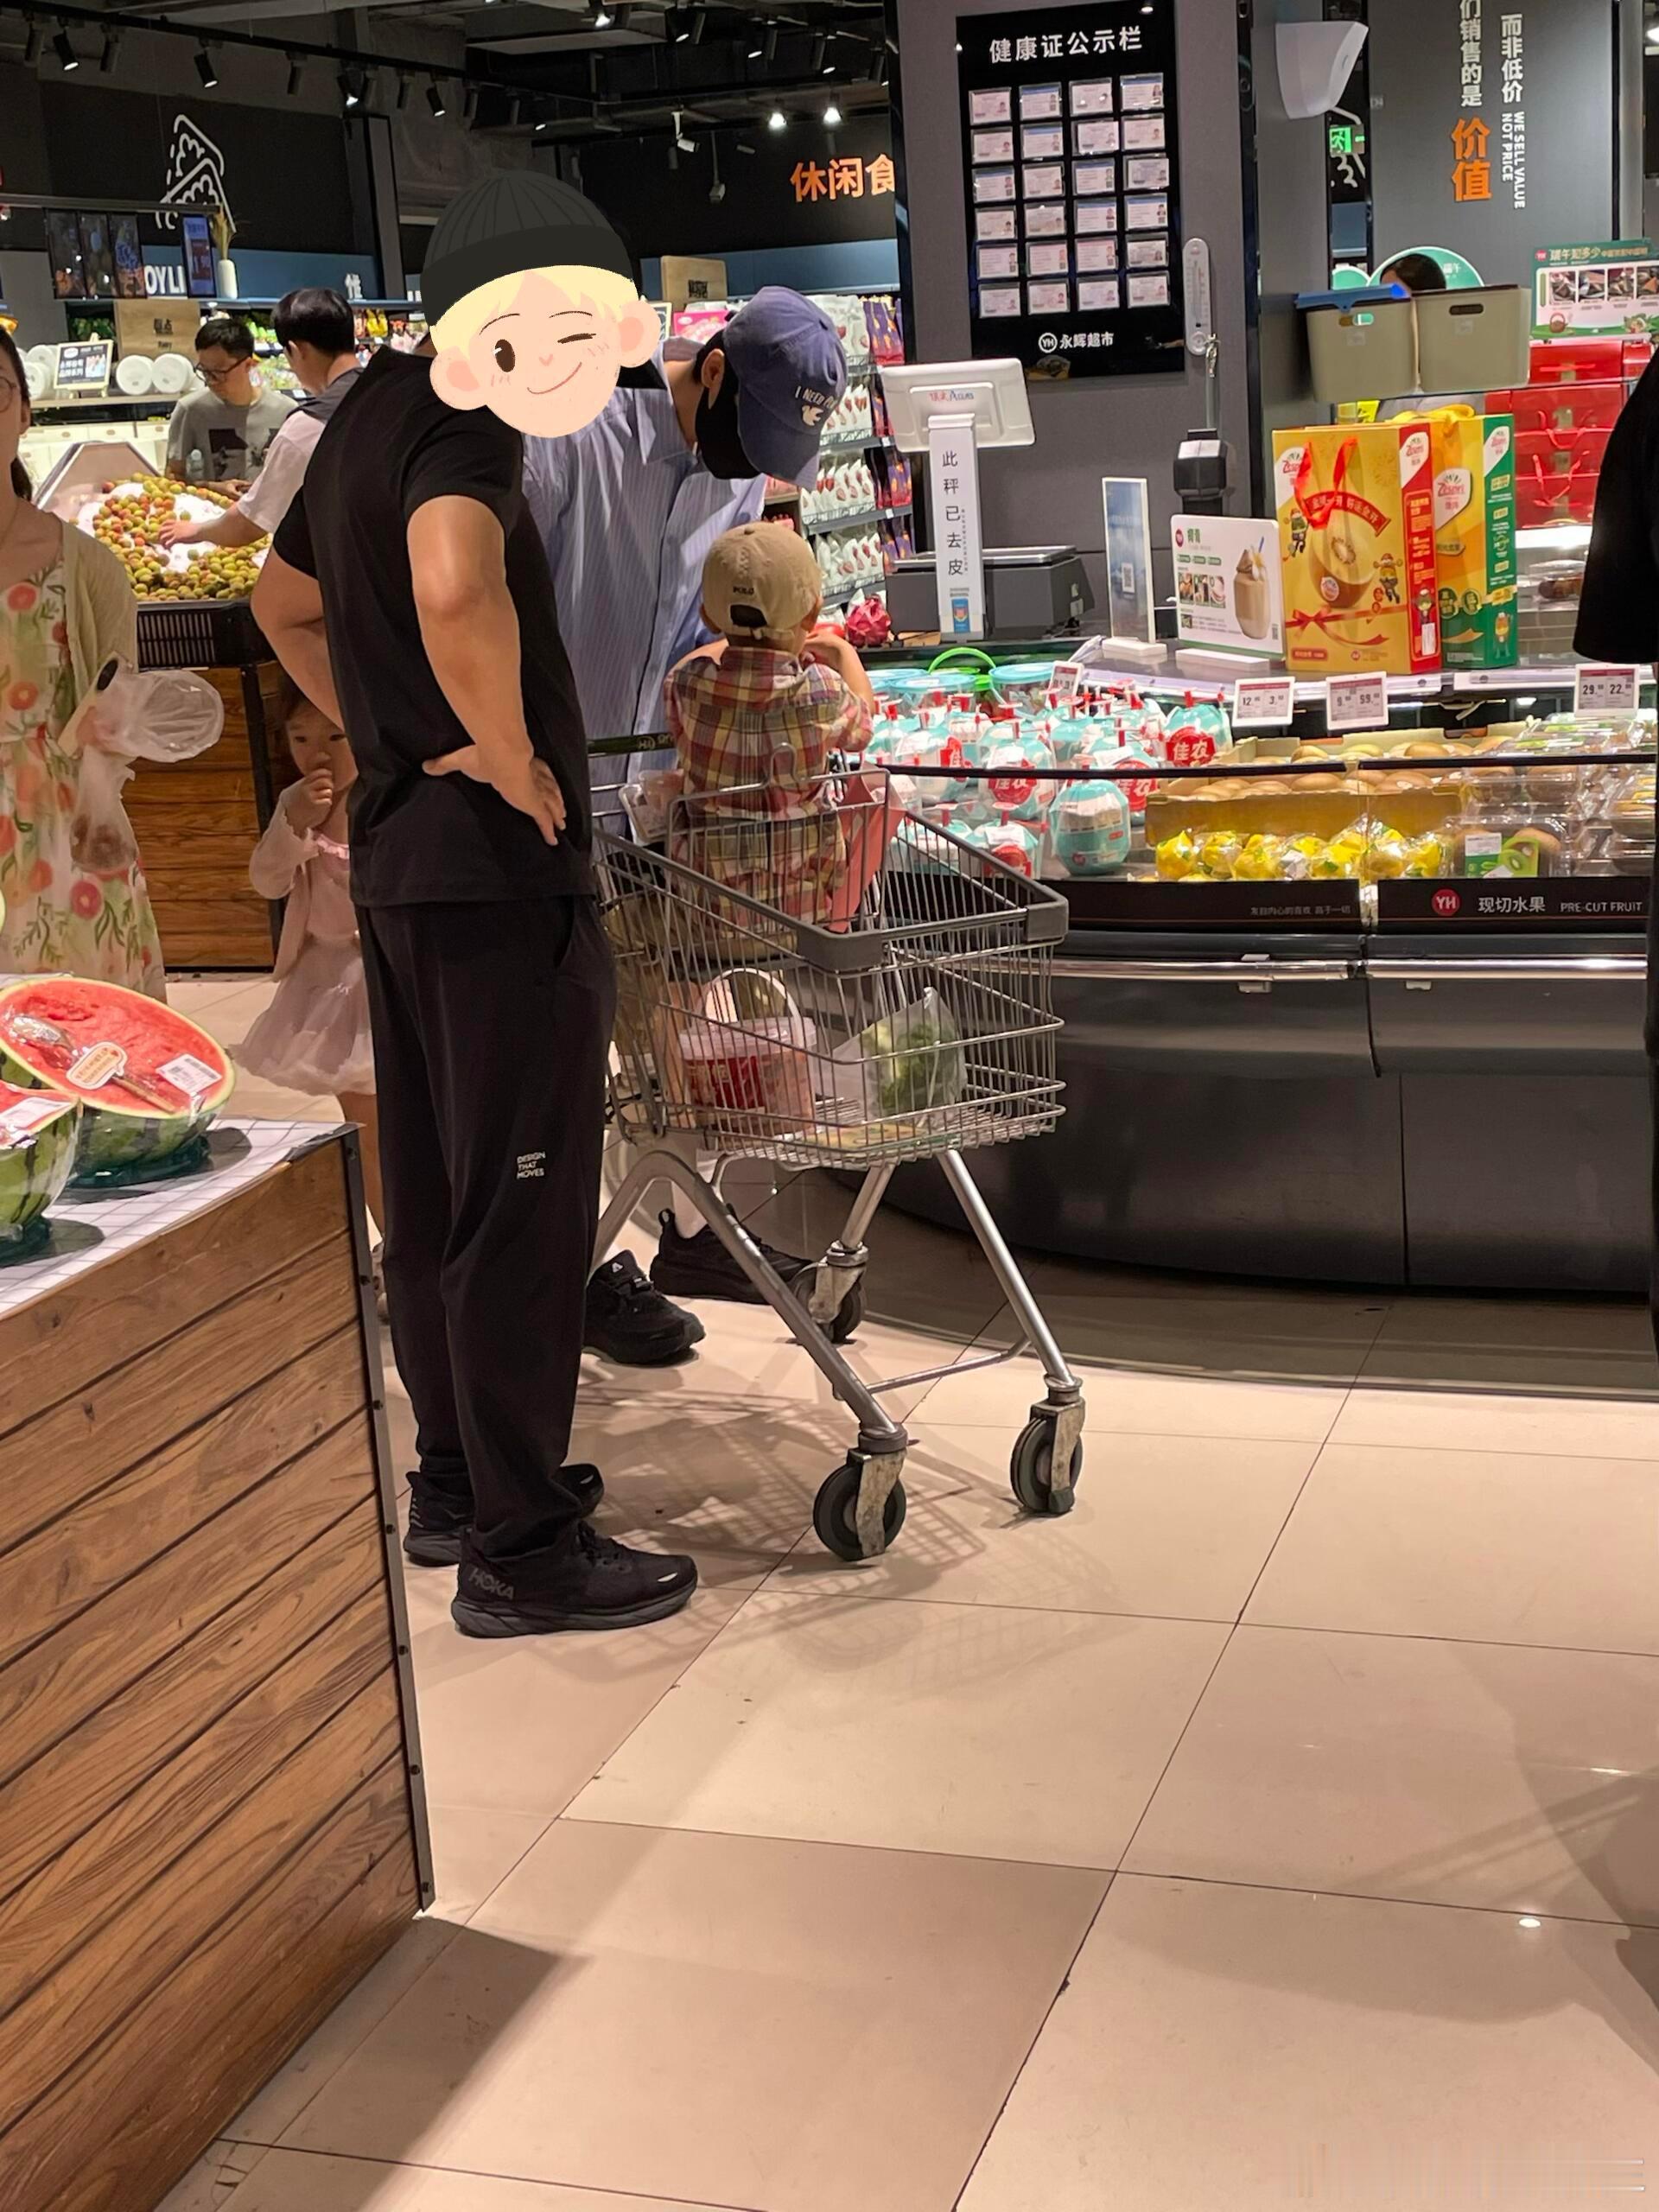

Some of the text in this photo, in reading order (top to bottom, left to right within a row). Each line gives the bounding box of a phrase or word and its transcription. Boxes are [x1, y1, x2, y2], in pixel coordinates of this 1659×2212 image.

[989, 26, 1141, 63] 健康证公示栏
[1500, 13, 1523, 103] 而非低价
[1452, 118, 1492, 201] 价值
[1501, 113, 1514, 181] NOT PRICE
[1513, 111, 1526, 209] WE SELL VALUE
[1059, 332, 1114, 349] 永辉超市
[802, 388, 825, 405] NEED
[942, 450, 963, 575] 此秤已去皮
[1173, 741, 1210, 762] 佳农
[1435, 896, 1457, 909] YH
[1478, 895, 1546, 913] 现切水果
[1560, 901, 1643, 912] PRE-CUT FRUIT
[468, 1567, 515, 1599] HOKA
